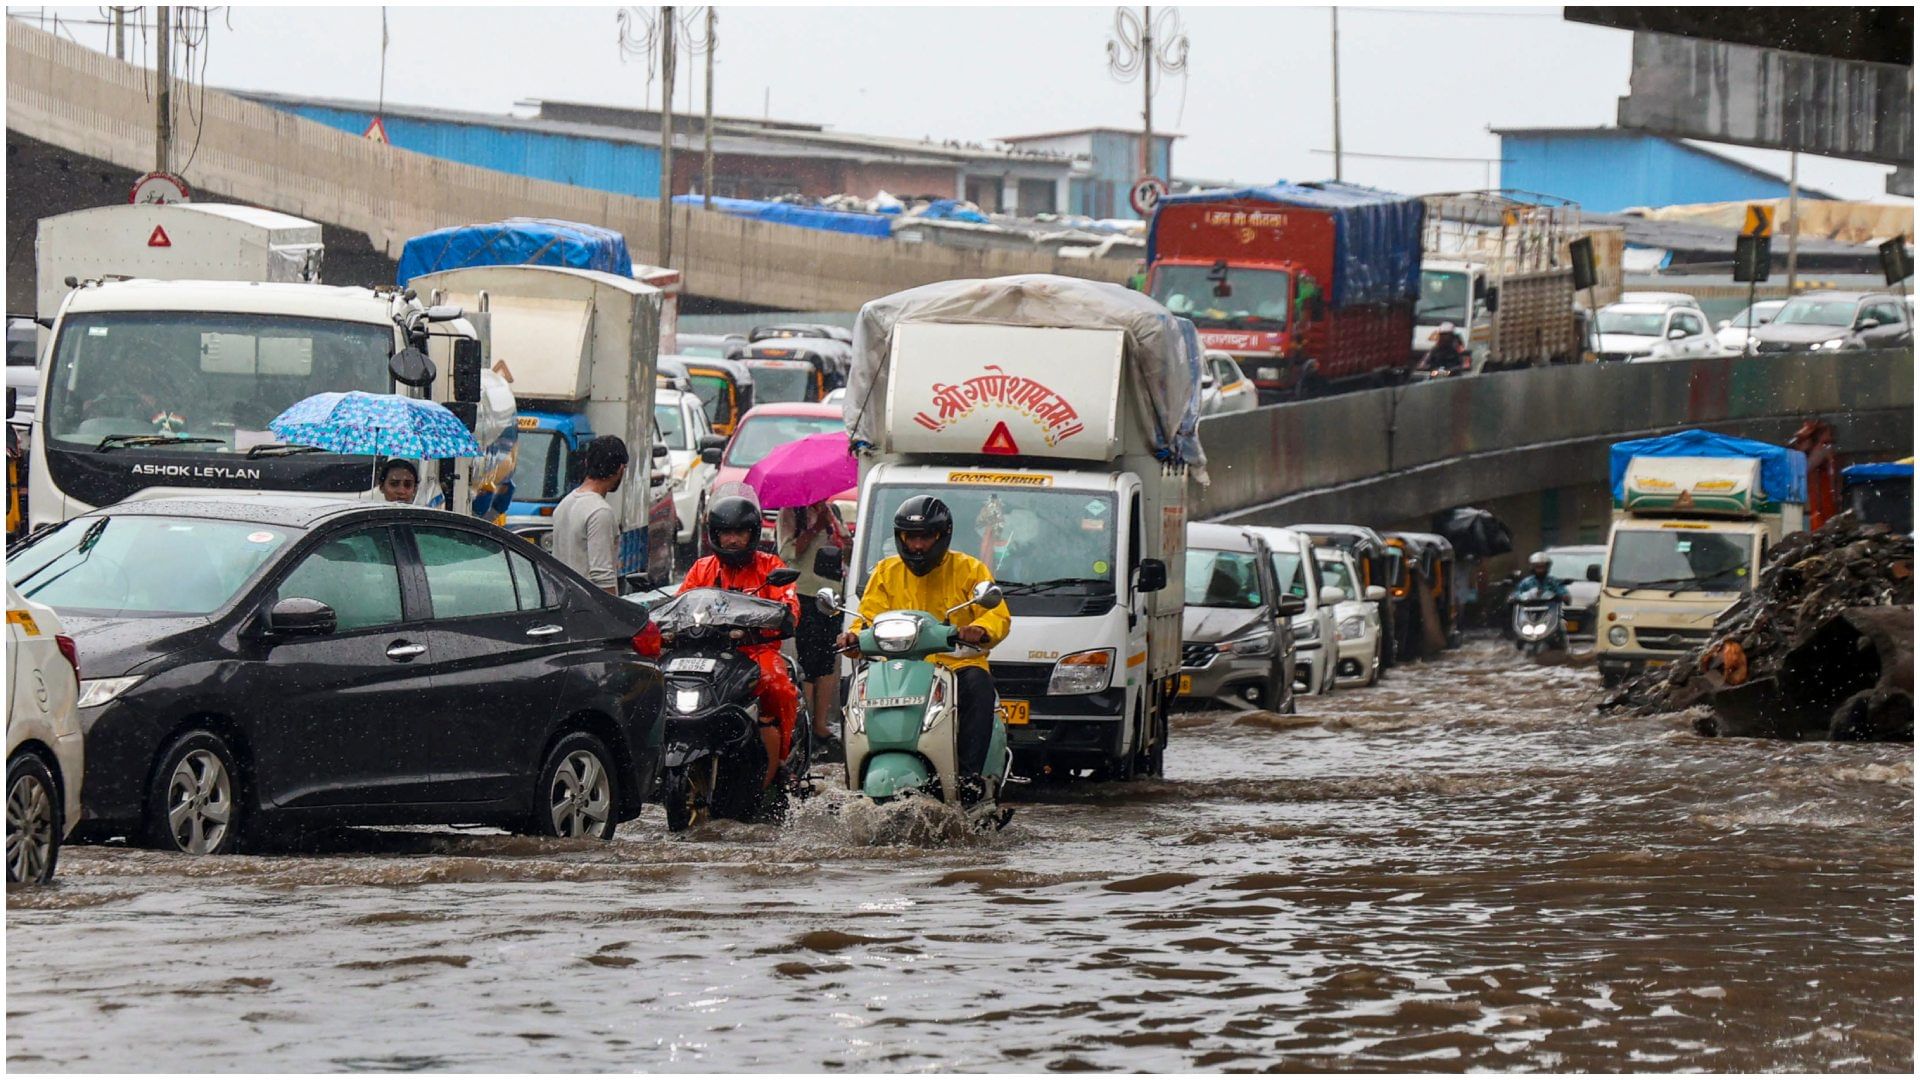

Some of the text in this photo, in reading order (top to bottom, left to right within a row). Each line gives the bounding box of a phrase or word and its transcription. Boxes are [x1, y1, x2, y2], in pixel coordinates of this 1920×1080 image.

[131, 464, 260, 480] ASHOK LEYLAN
[950, 472, 992, 483] GOODS
[1028, 650, 1059, 659] GOLD
